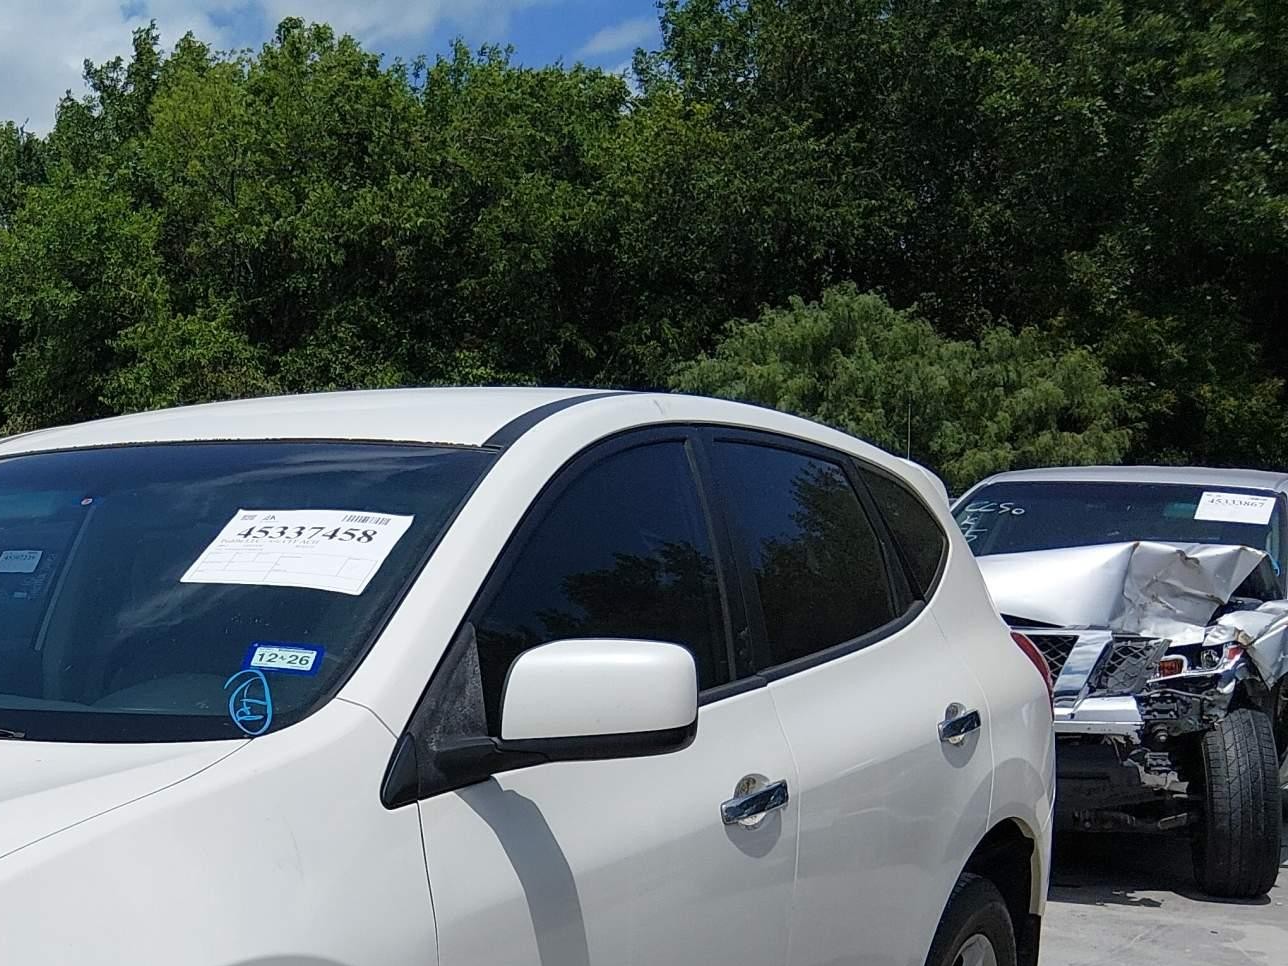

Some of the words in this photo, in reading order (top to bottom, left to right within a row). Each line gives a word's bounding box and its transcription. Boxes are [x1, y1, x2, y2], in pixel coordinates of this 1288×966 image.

[237, 525, 378, 544] 45337458
[257, 652, 279, 664] 12
[286, 654, 311, 666] 26
